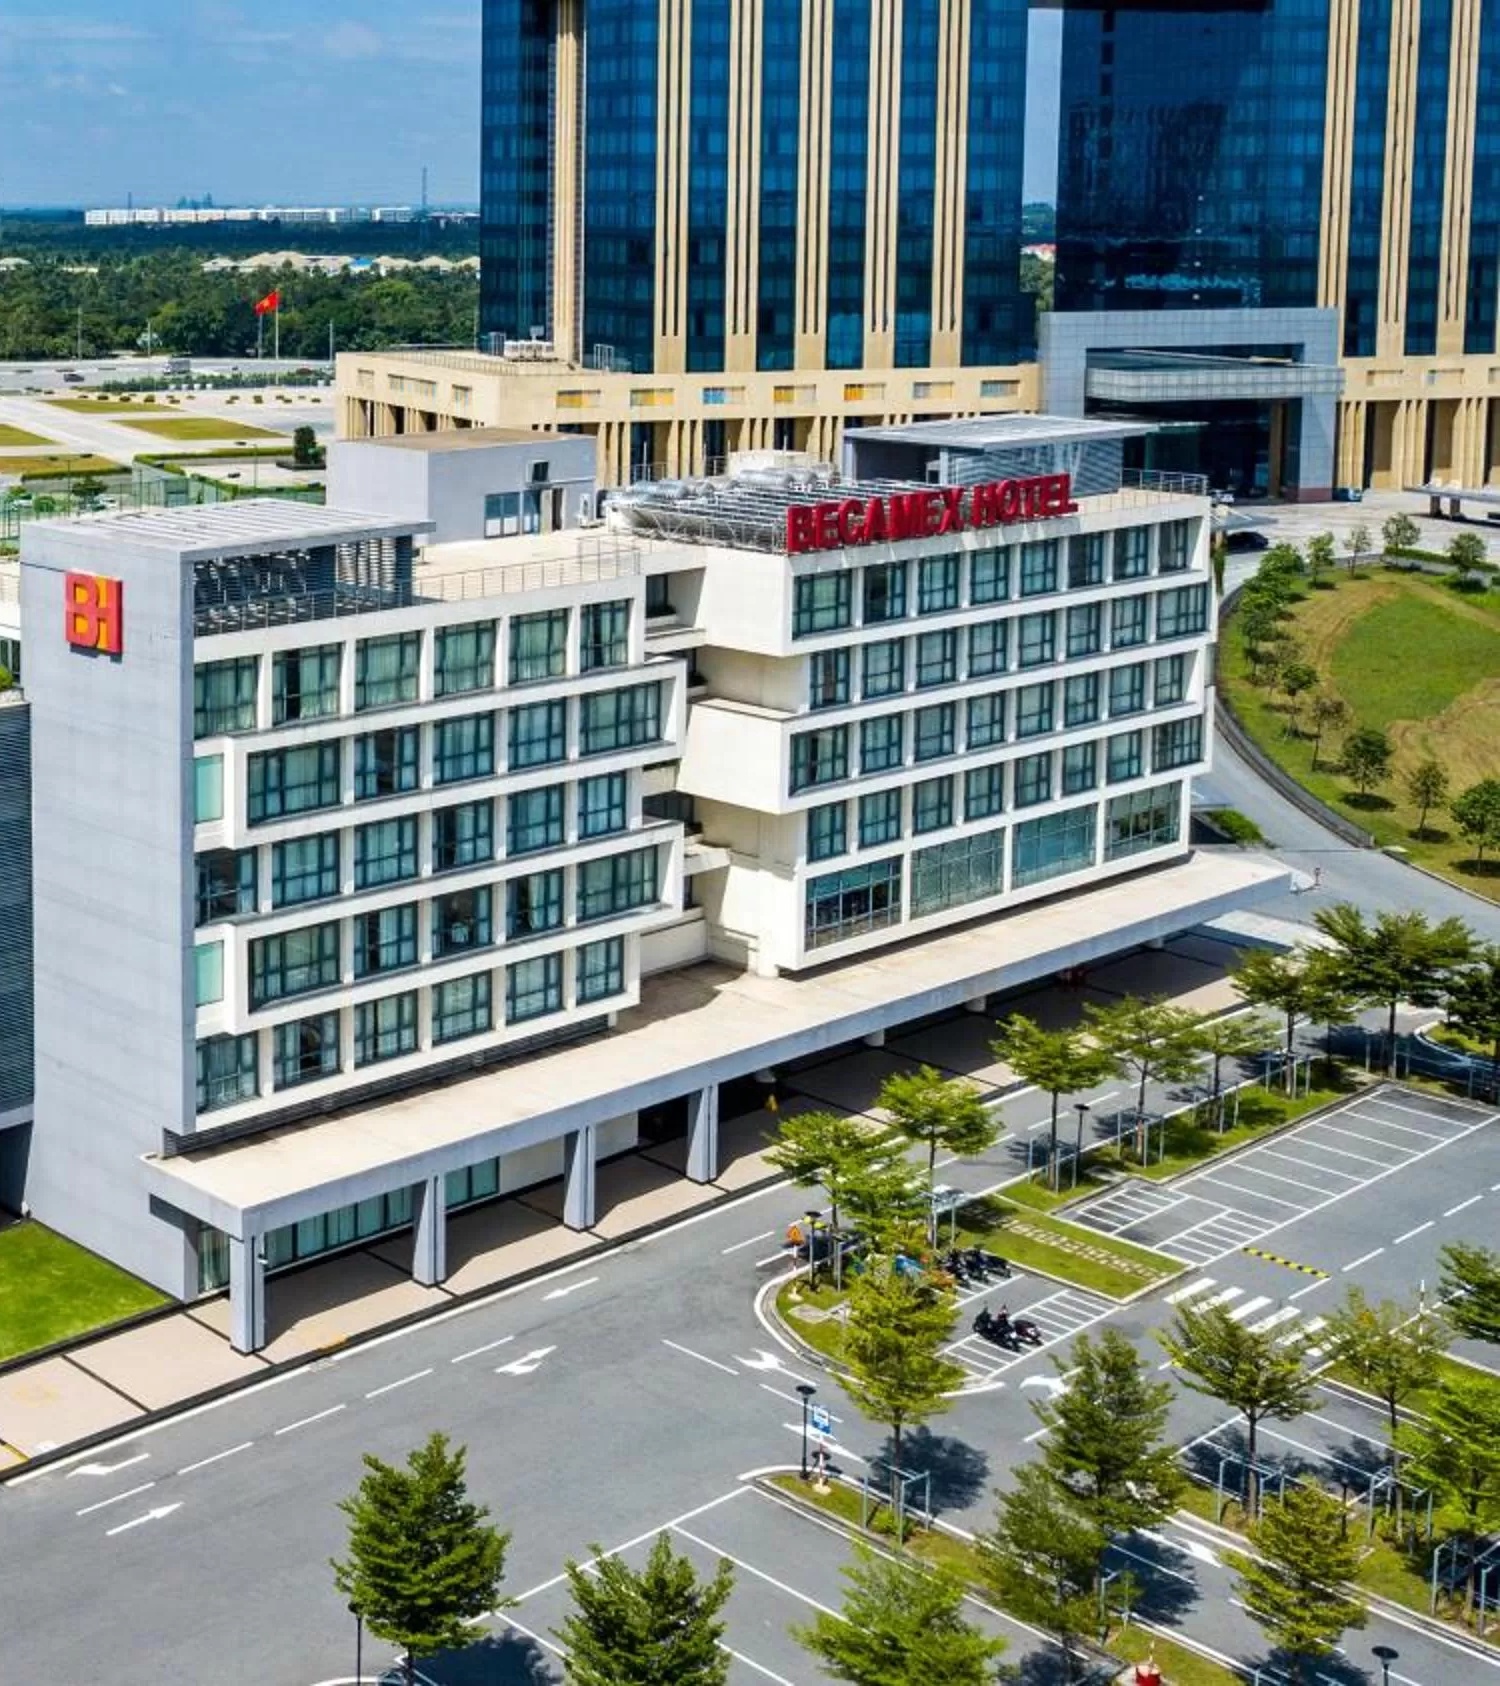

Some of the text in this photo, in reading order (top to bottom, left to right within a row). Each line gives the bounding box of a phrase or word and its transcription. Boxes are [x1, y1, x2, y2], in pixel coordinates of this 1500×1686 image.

[787, 474, 1078, 552] BECAMEX HOTEL
[65, 570, 123, 655] BH
